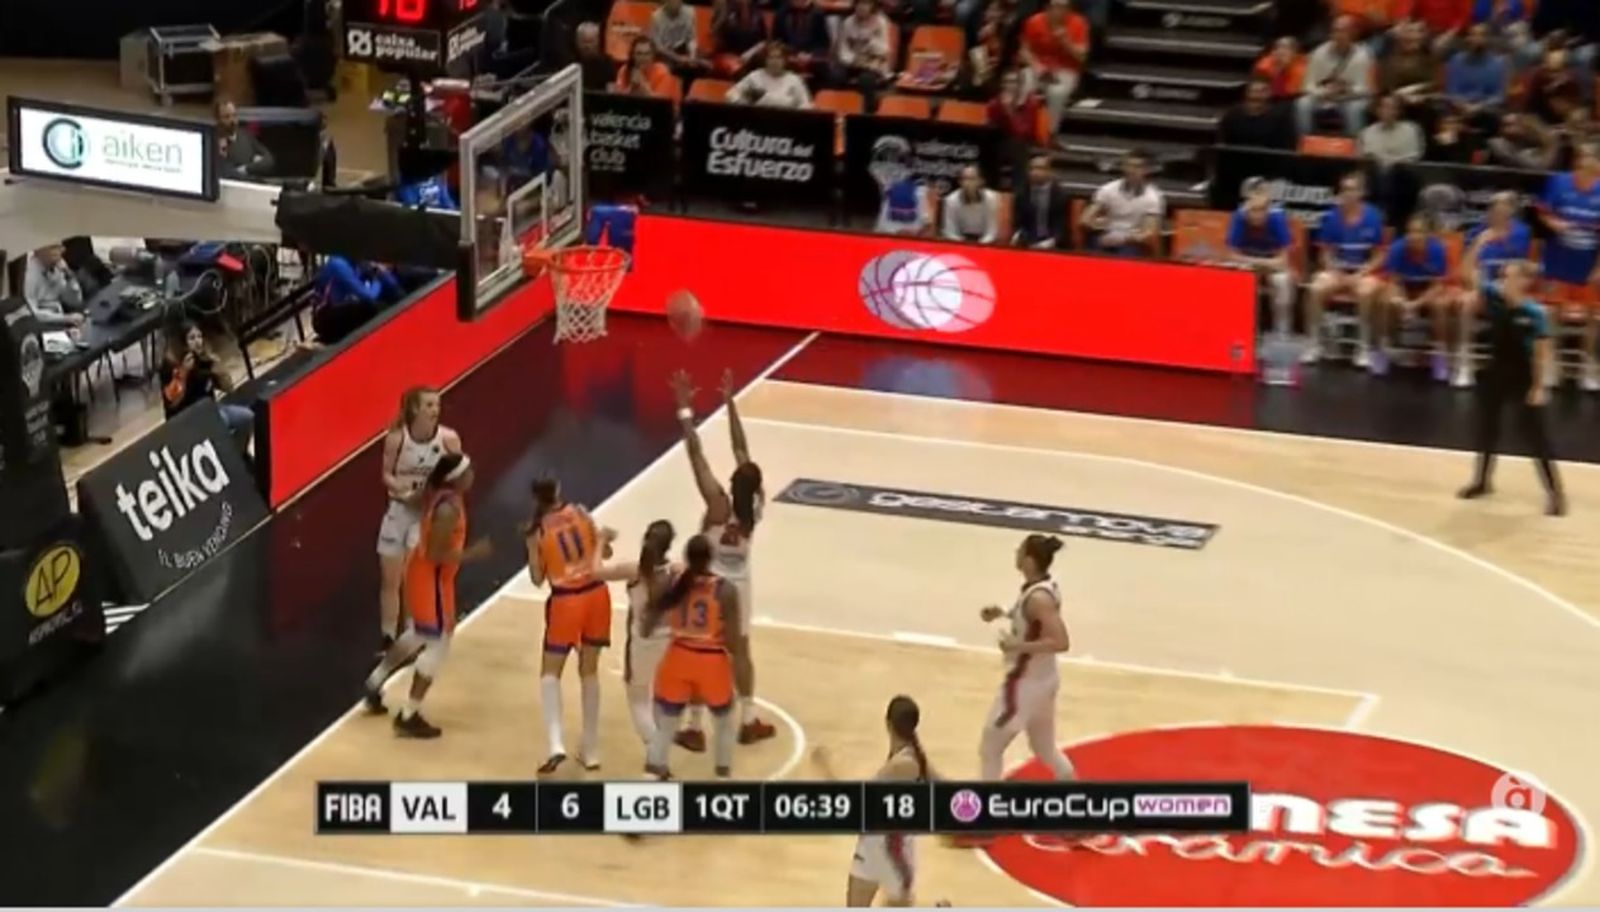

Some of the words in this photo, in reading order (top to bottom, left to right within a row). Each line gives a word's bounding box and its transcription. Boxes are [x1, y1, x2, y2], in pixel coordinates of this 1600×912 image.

[375, 45, 438, 61] popular
[103, 130, 183, 165] aiken
[709, 126, 795, 155] Cultura
[707, 150, 815, 182] Esfuerzo
[115, 438, 230, 541] teika
[557, 526, 585, 563] 11
